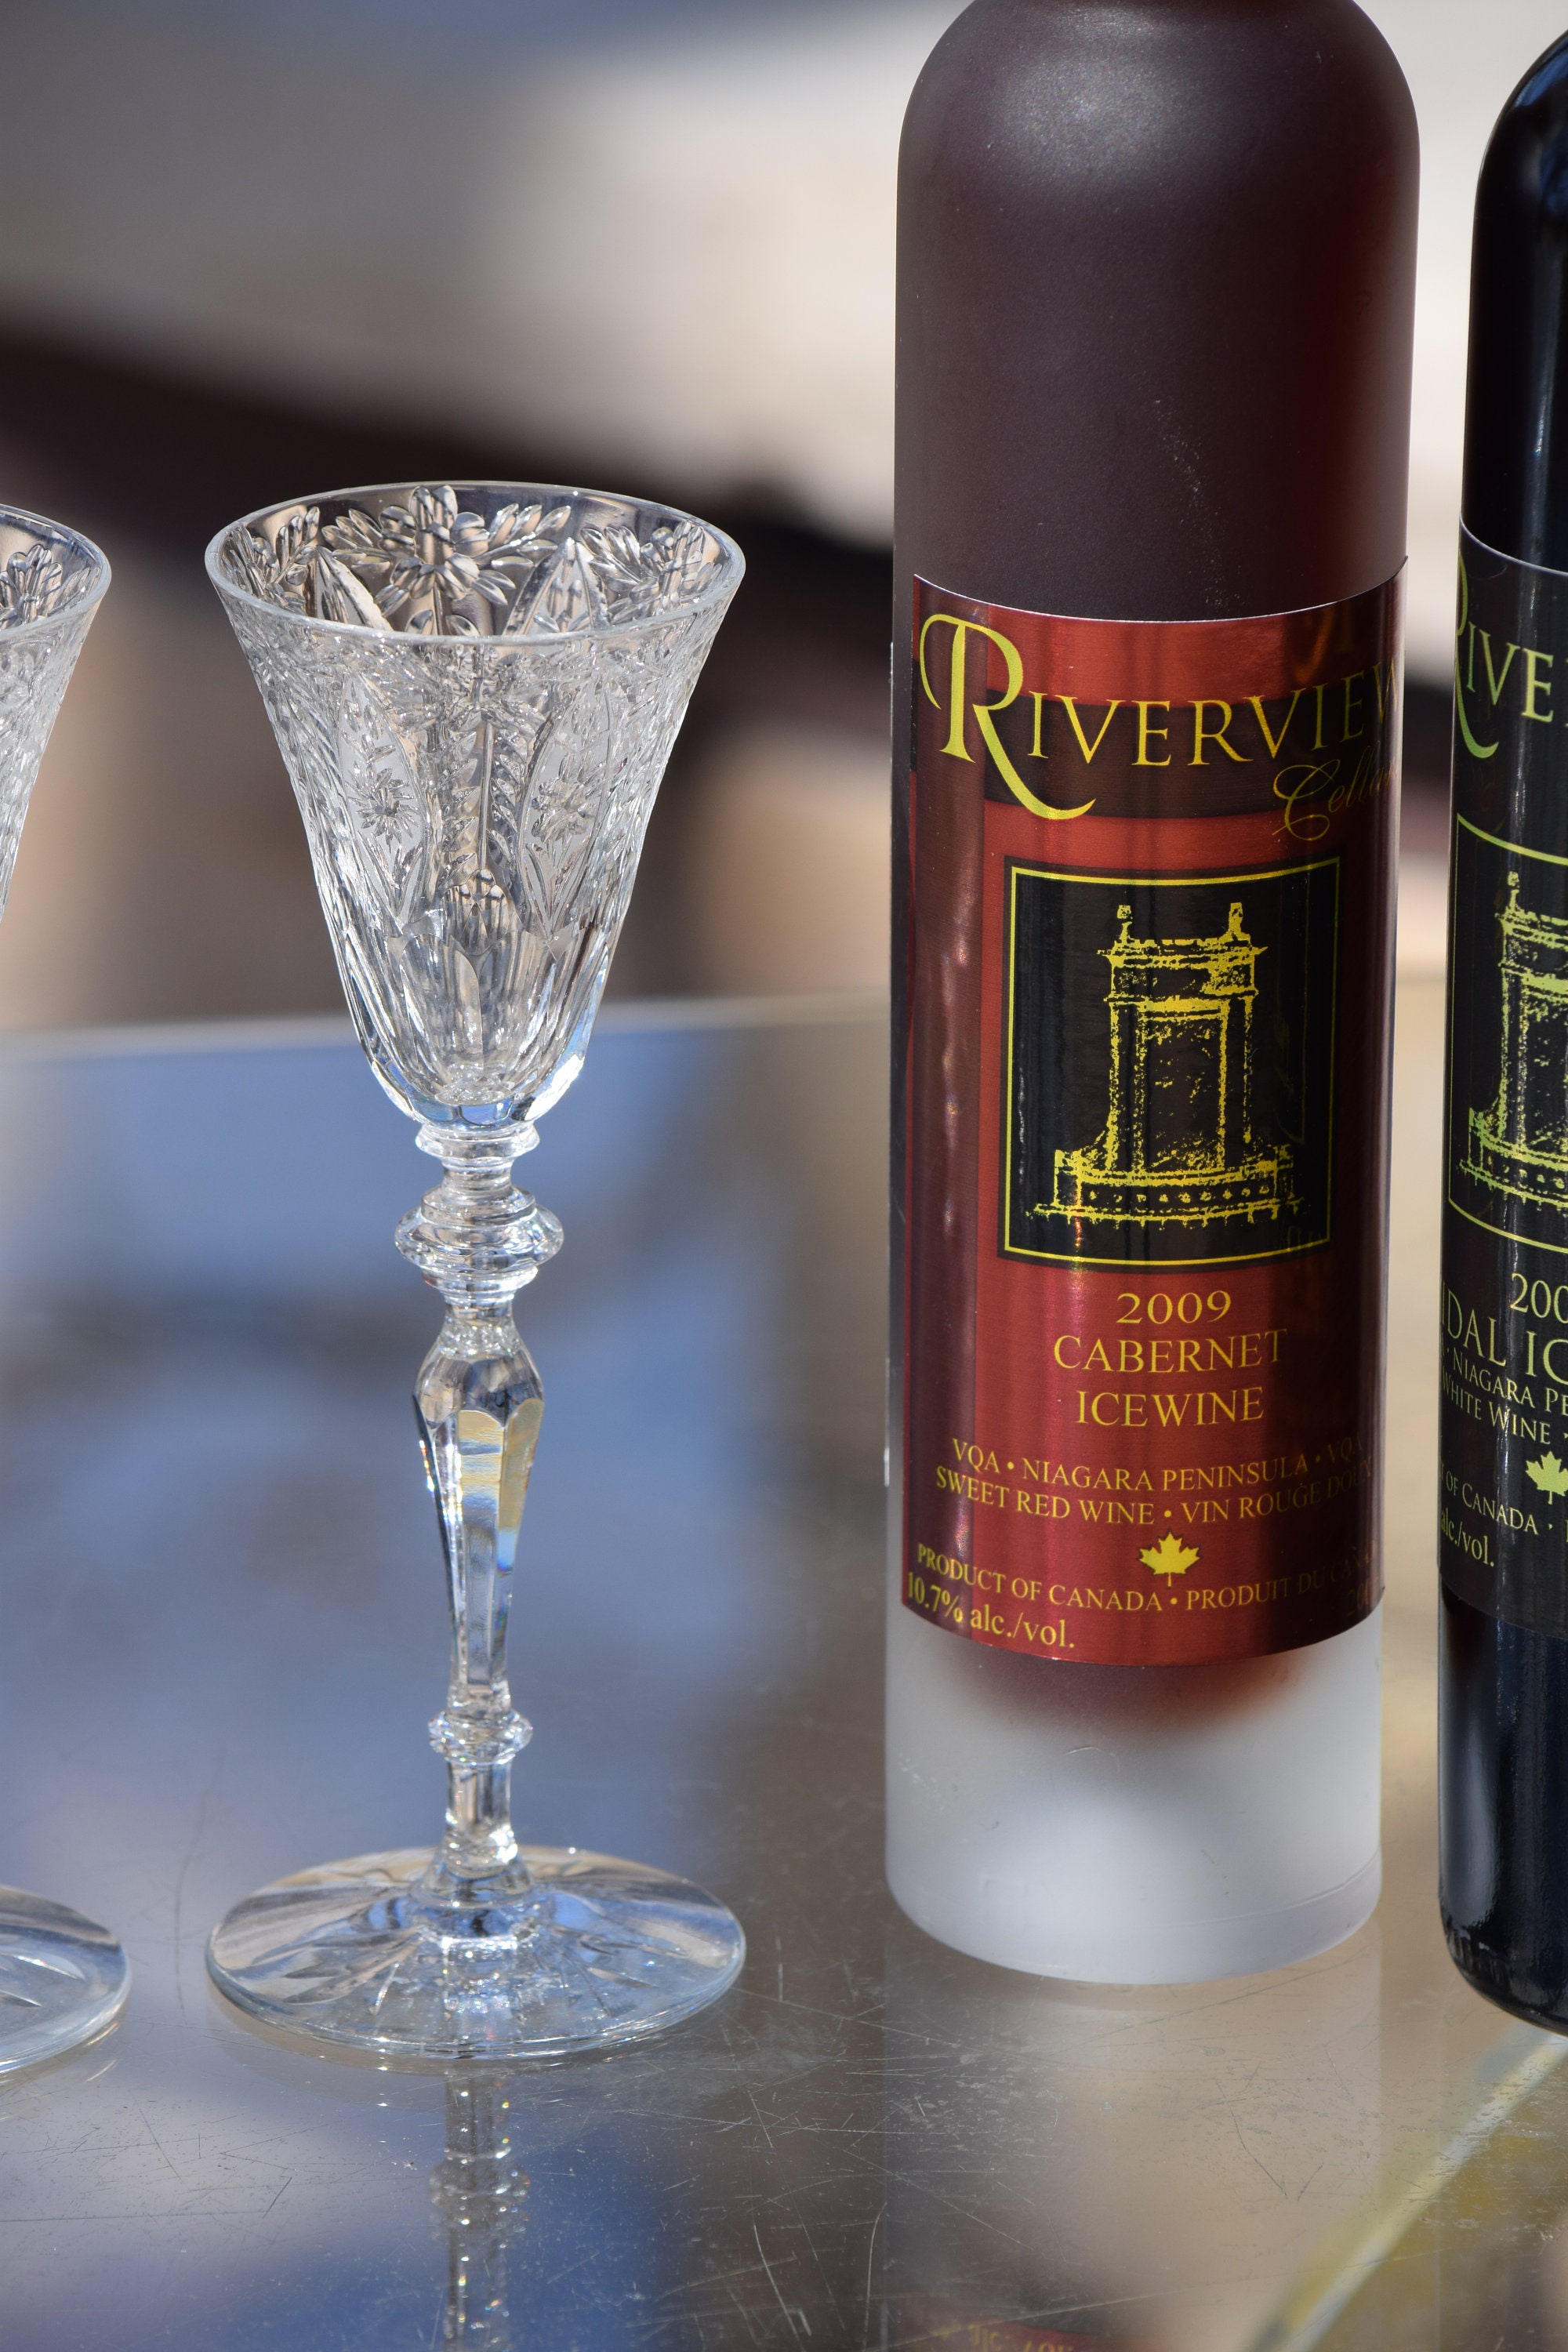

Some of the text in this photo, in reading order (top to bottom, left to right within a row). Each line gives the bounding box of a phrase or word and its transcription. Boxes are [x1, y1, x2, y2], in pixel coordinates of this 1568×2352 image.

[1116, 1290, 1233, 1325] 2009
[1054, 1329, 1287, 1374] CABERNET
[1453, 1347, 1536, 1409] NIAGARA
[1075, 1386, 1265, 1427] ICEWINE
[1490, 1402, 1551, 1445] WINE
[952, 1434, 1363, 1491] VQA NIAGARA PENINSULA VQA
[936, 1465, 1010, 1508] SWEET
[1017, 1489, 1070, 1519] RED
[1079, 1500, 1155, 1525] WINE
[1181, 1500, 1231, 1523] VIN
[1239, 1482, 1322, 1519] ROUGE
[1446, 1471, 1539, 1536] OF CANADA
[917, 1543, 1006, 1595] PRODUCT
[1011, 1577, 1042, 1599] OF
[1049, 1585, 1163, 1612] CANADA
[1185, 1581, 1292, 1610] PRODUIT
[1298, 1568, 1326, 1594] DU
[908, 1572, 1075, 1649] 10.7% alc./vol.
